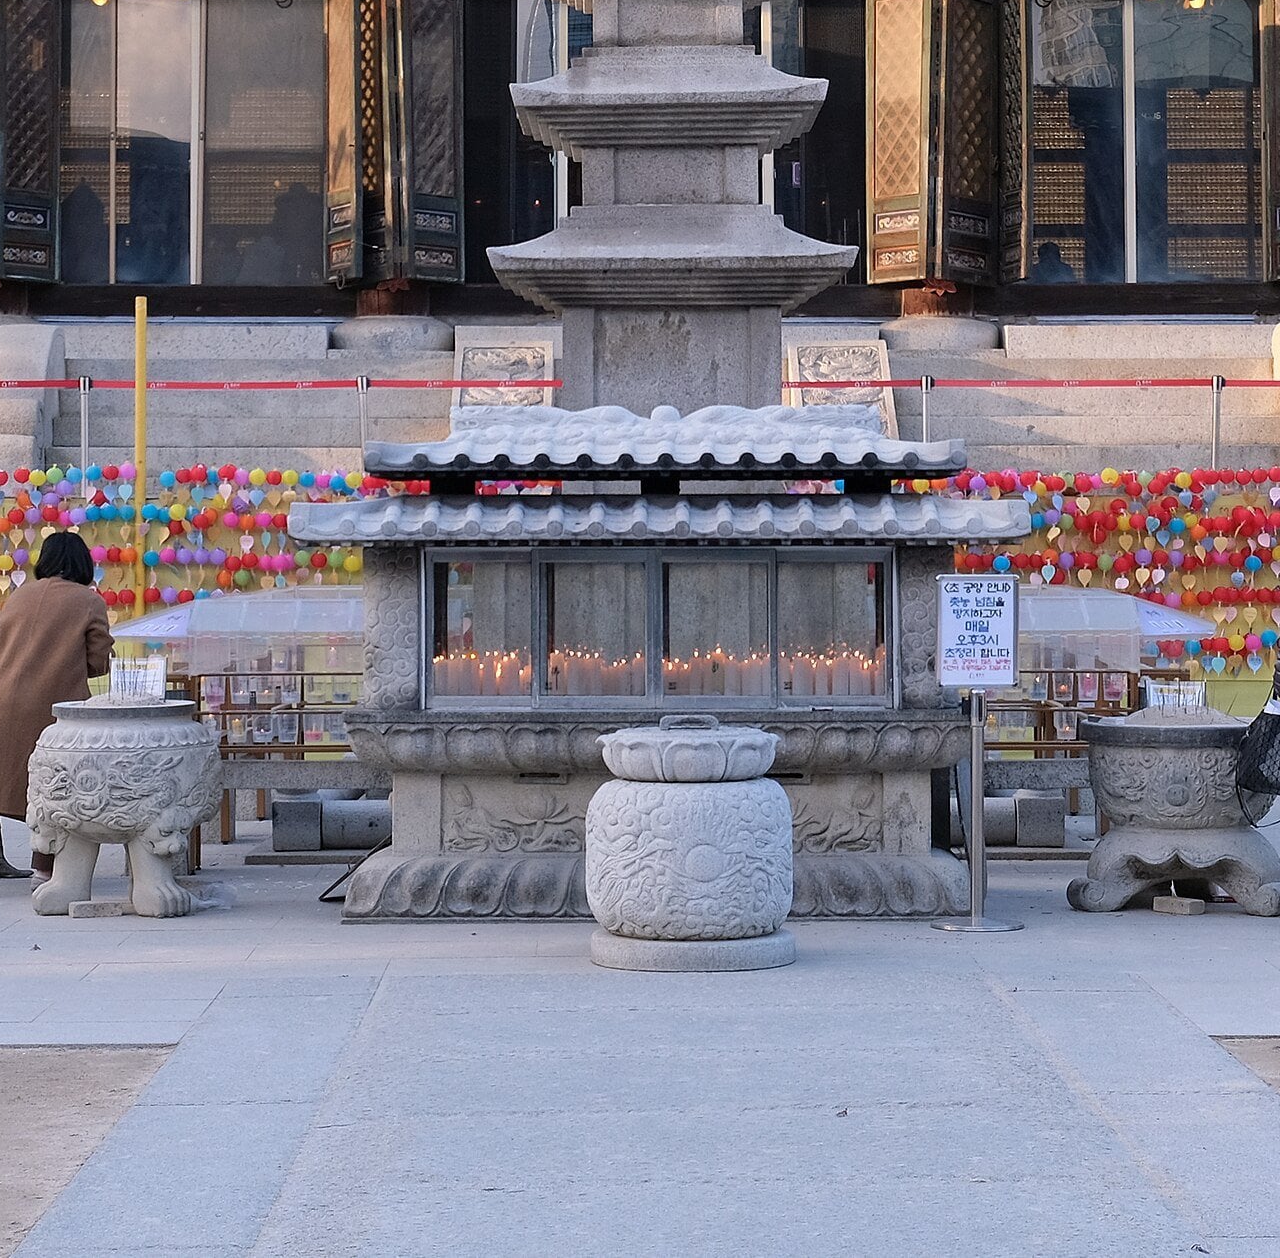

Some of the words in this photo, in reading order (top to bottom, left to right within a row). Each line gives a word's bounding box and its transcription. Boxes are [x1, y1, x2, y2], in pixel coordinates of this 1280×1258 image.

[963, 582, 983, 593] 공양
[952, 608, 1003, 619] 방지하고자
[965, 620, 990, 632] 매일
[955, 634, 999, 646] 오후3시
[944, 647, 976, 658] 초정리
